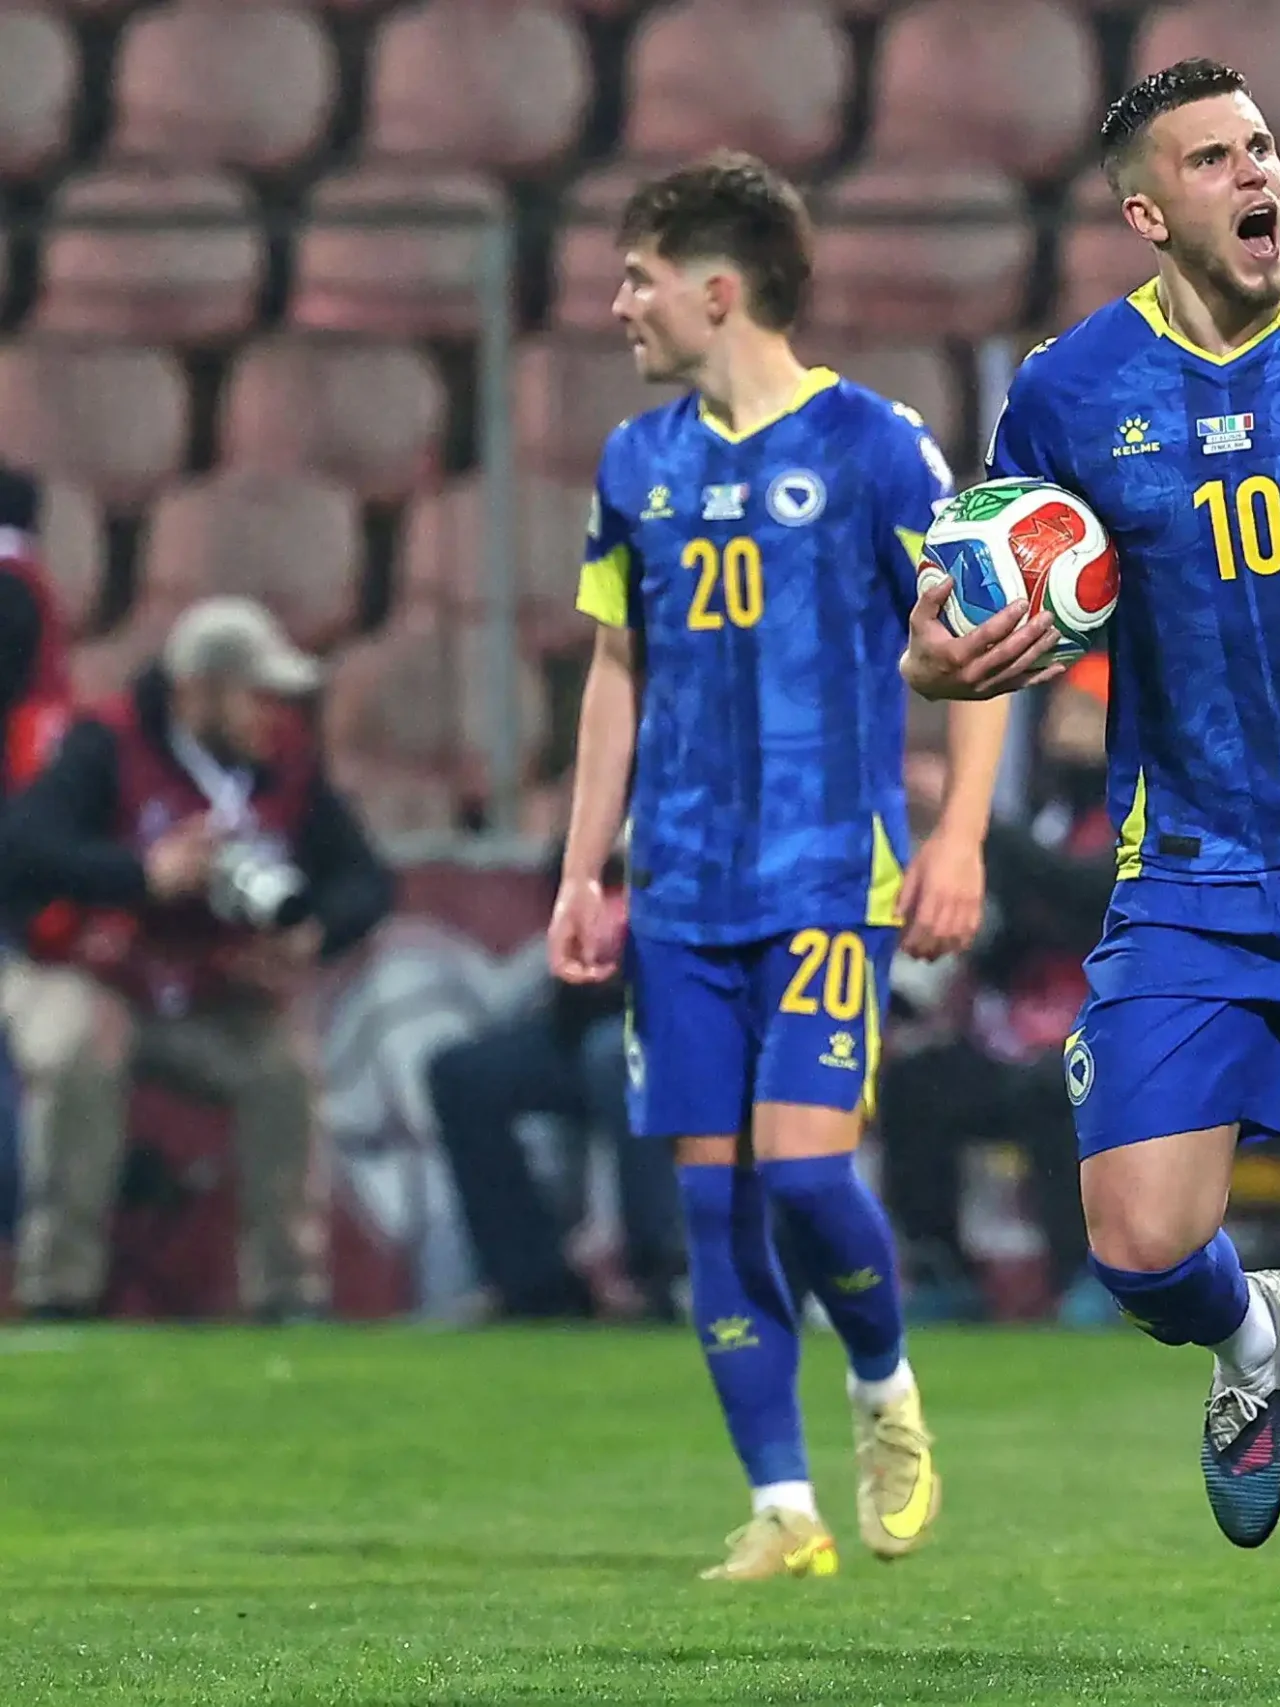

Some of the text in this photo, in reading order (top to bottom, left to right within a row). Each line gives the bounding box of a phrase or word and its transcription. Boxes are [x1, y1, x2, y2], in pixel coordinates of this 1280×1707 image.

[1112, 441, 1161, 457] KELME
[681, 536, 764, 631] 20
[779, 927, 866, 1021] 20
